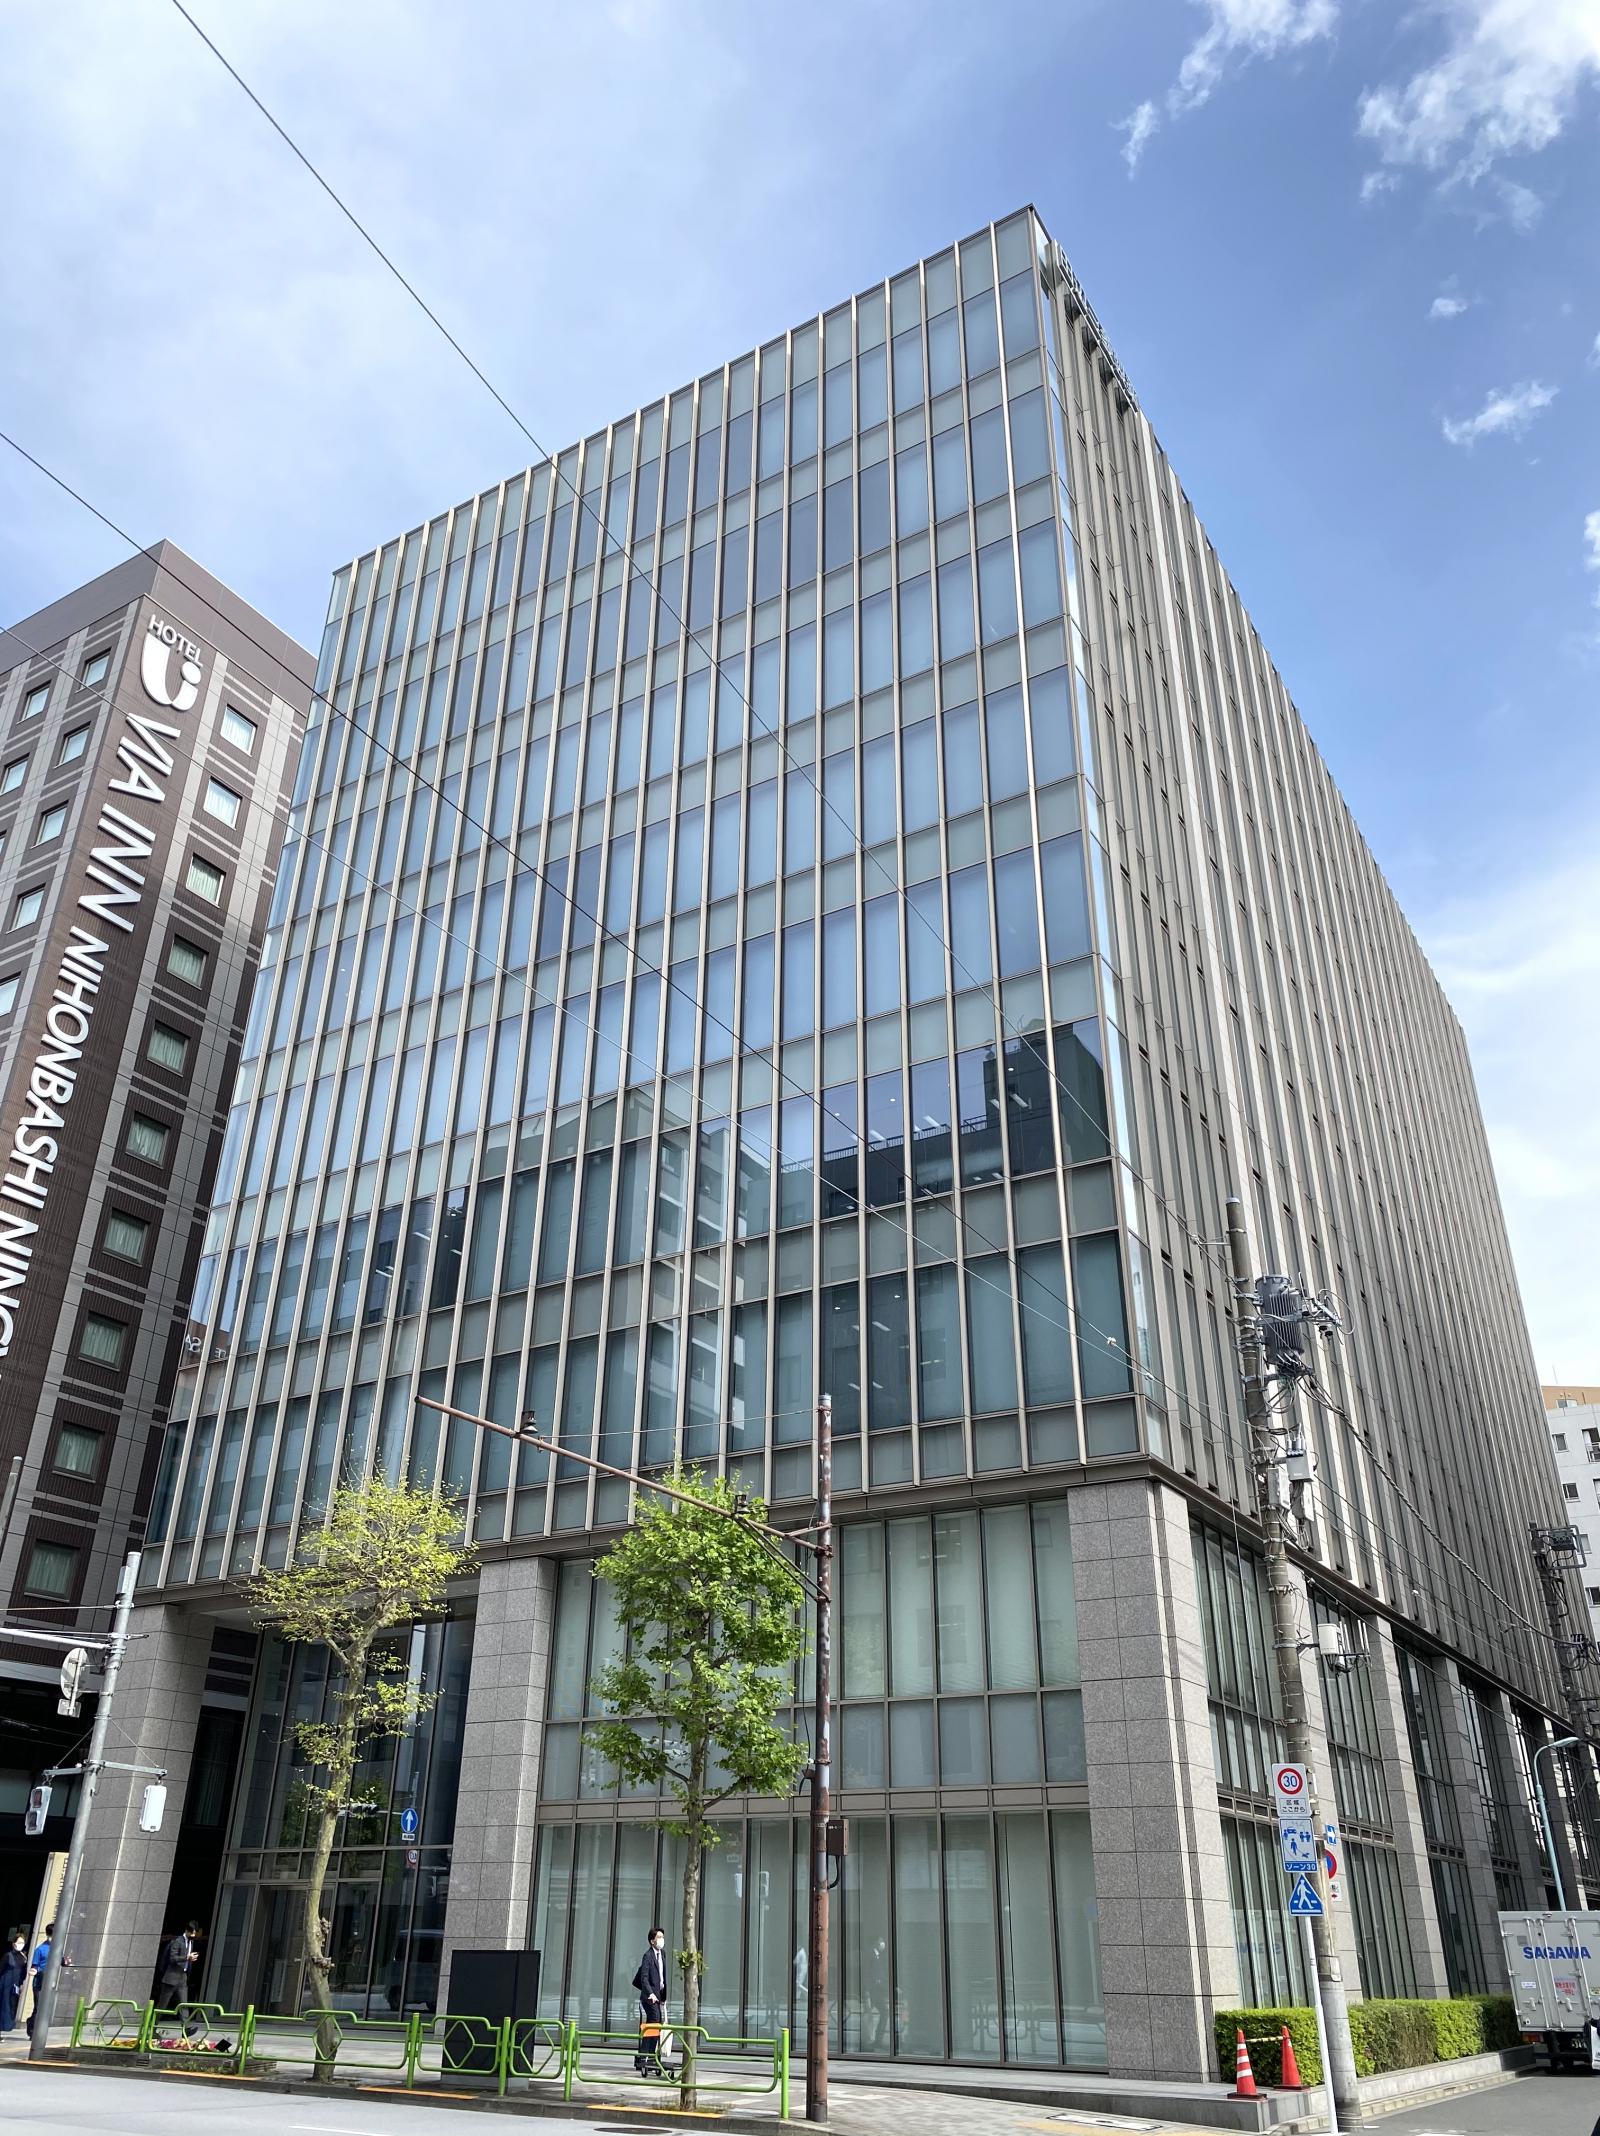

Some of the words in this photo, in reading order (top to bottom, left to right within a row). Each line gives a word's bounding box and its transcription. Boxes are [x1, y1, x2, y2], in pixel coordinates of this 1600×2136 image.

[148, 614, 203, 667] HOTEL
[108, 713, 181, 801] VIA
[78, 803, 156, 932] INN
[0, 925, 110, 1209] NIHONBASHI
[1283, 1775, 1298, 1788] 30
[1523, 1946, 1591, 1960] SAGAWA
